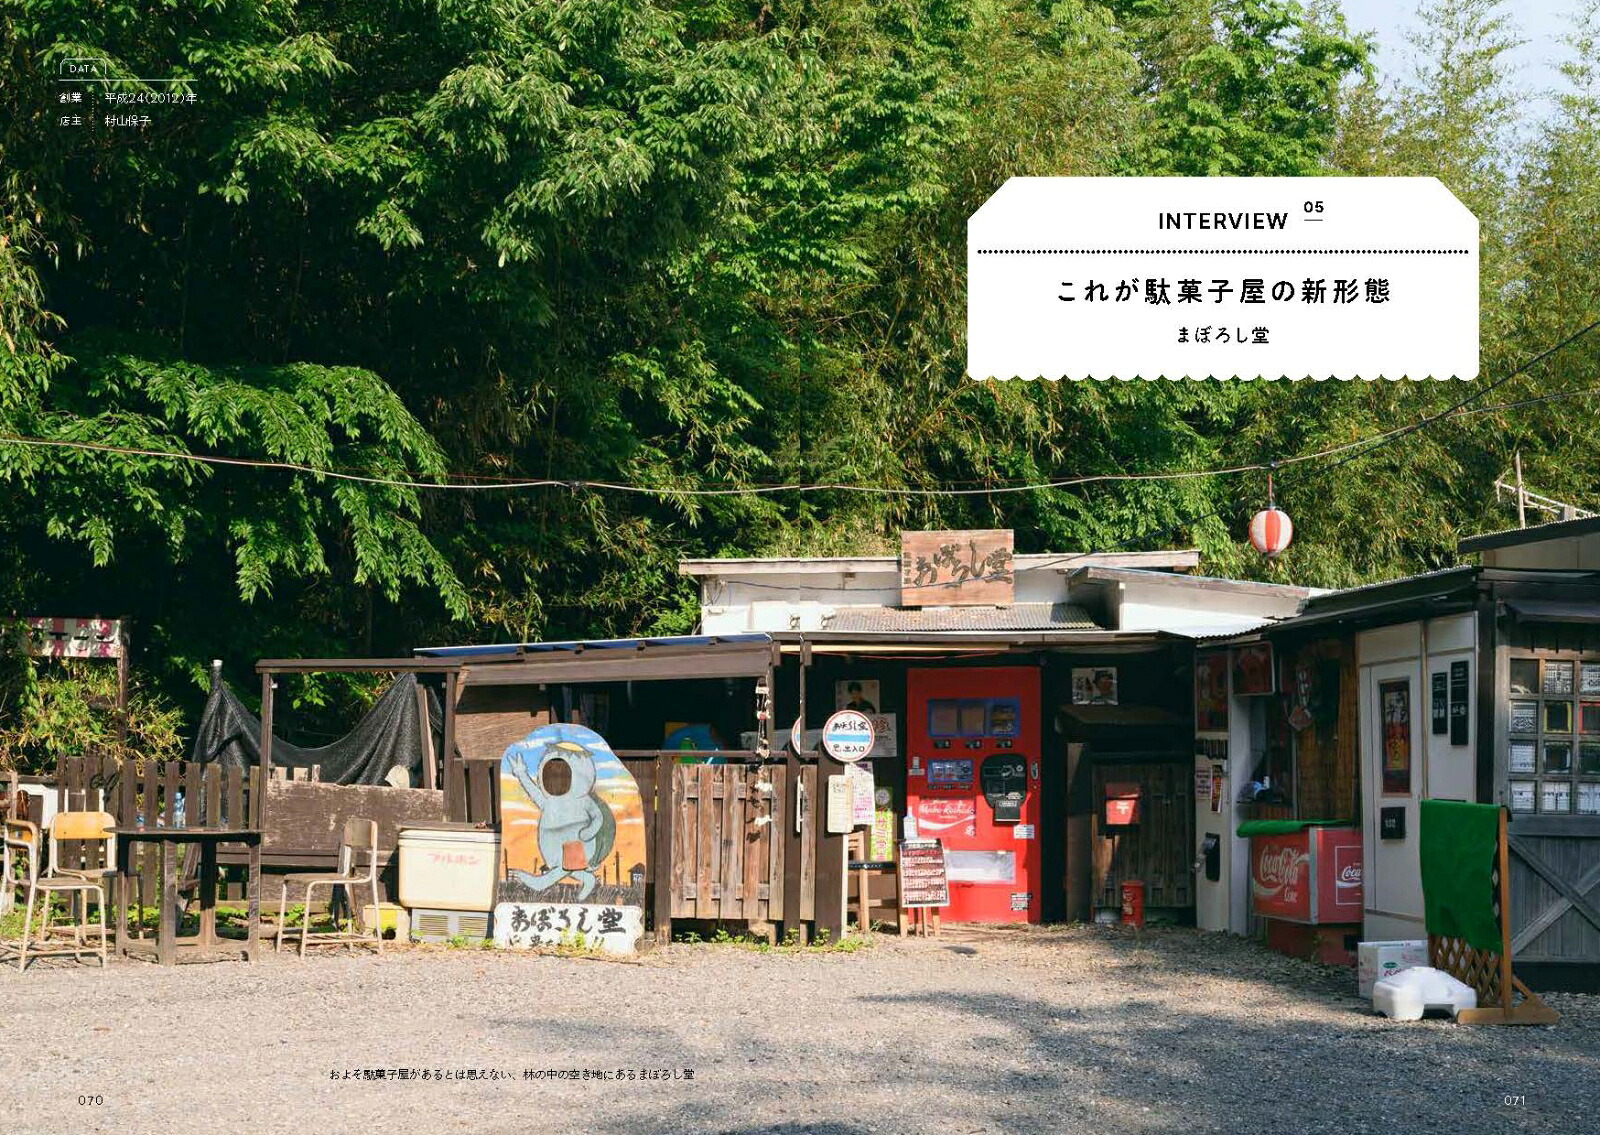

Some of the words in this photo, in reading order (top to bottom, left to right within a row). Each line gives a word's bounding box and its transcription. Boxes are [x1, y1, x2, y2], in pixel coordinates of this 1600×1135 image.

[511, 905, 626, 934] まぼろし堂
